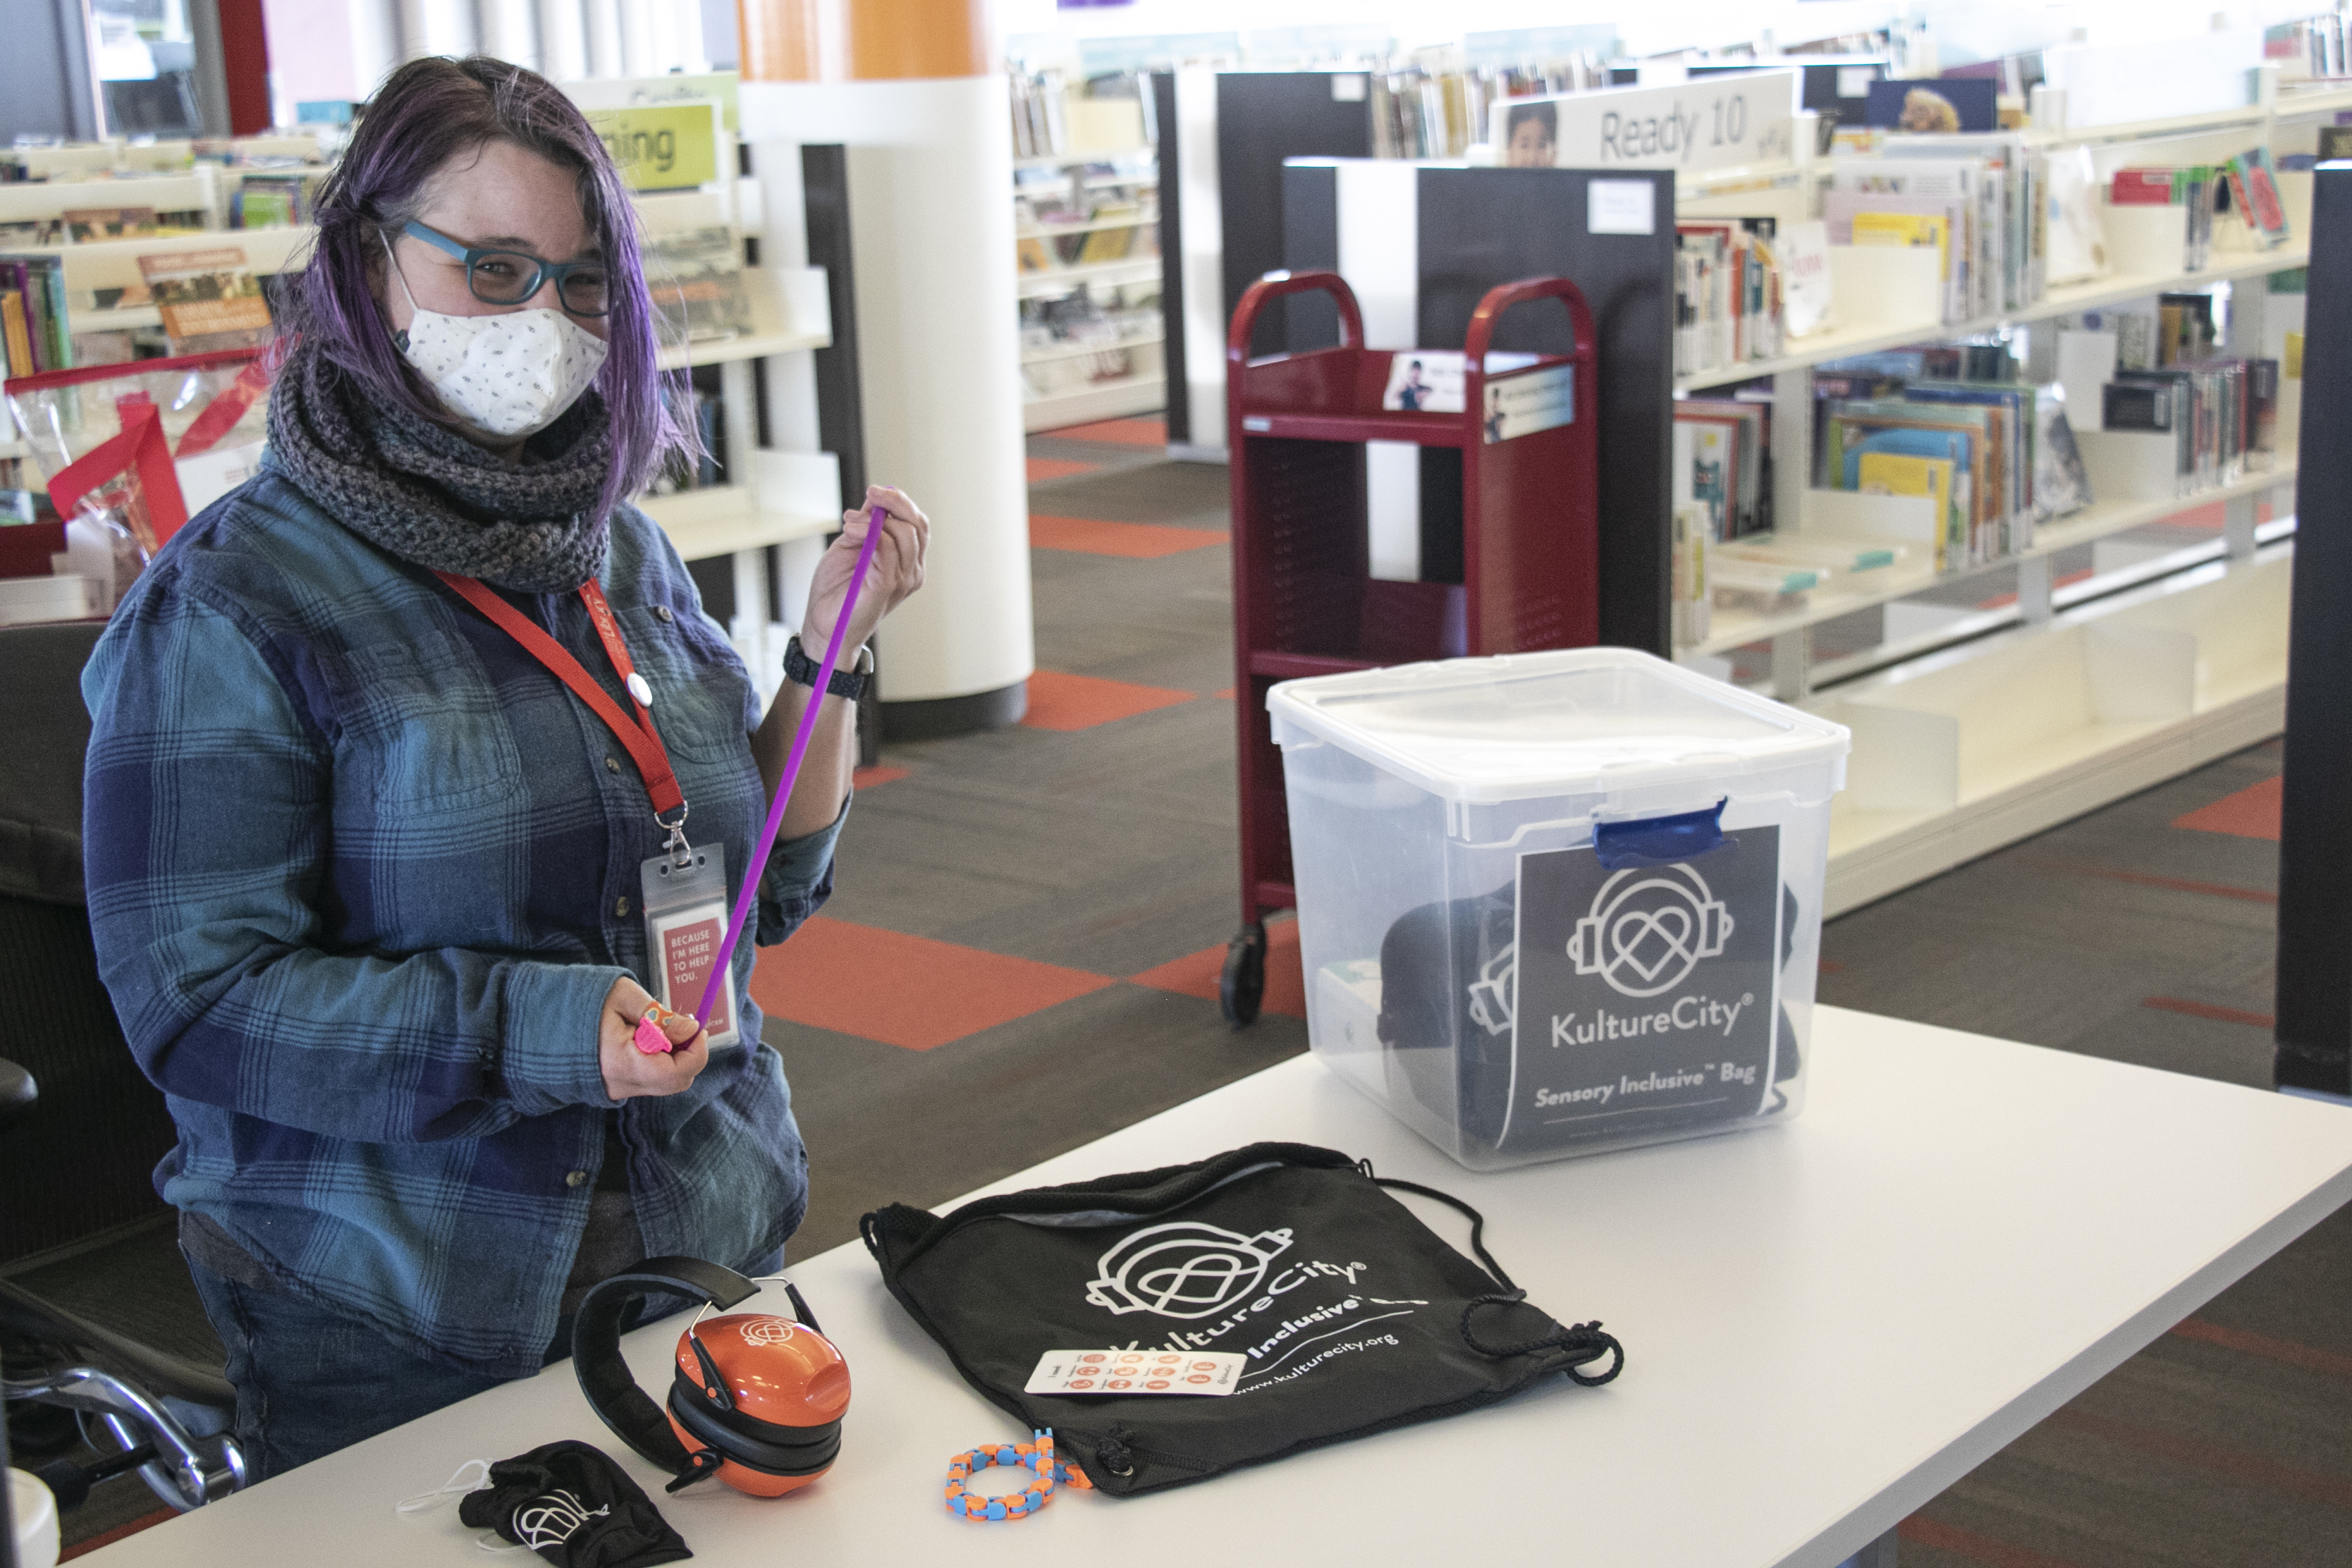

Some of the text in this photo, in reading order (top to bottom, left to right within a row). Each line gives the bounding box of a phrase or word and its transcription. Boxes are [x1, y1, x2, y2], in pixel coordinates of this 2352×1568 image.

[1601, 100, 1700, 164] Ready
[1712, 94, 1747, 147] 10
[672, 930, 710, 947] BECAUSE
[673, 942, 710, 960] I'M HERE
[673, 955, 709, 971] TO HELP
[675, 971, 698, 984] YOU.
[1534, 1084, 1614, 1108] Sensory
[1720, 1062, 1756, 1085] Bag
[1233, 1334, 1399, 1395] www.kulturecity.org
